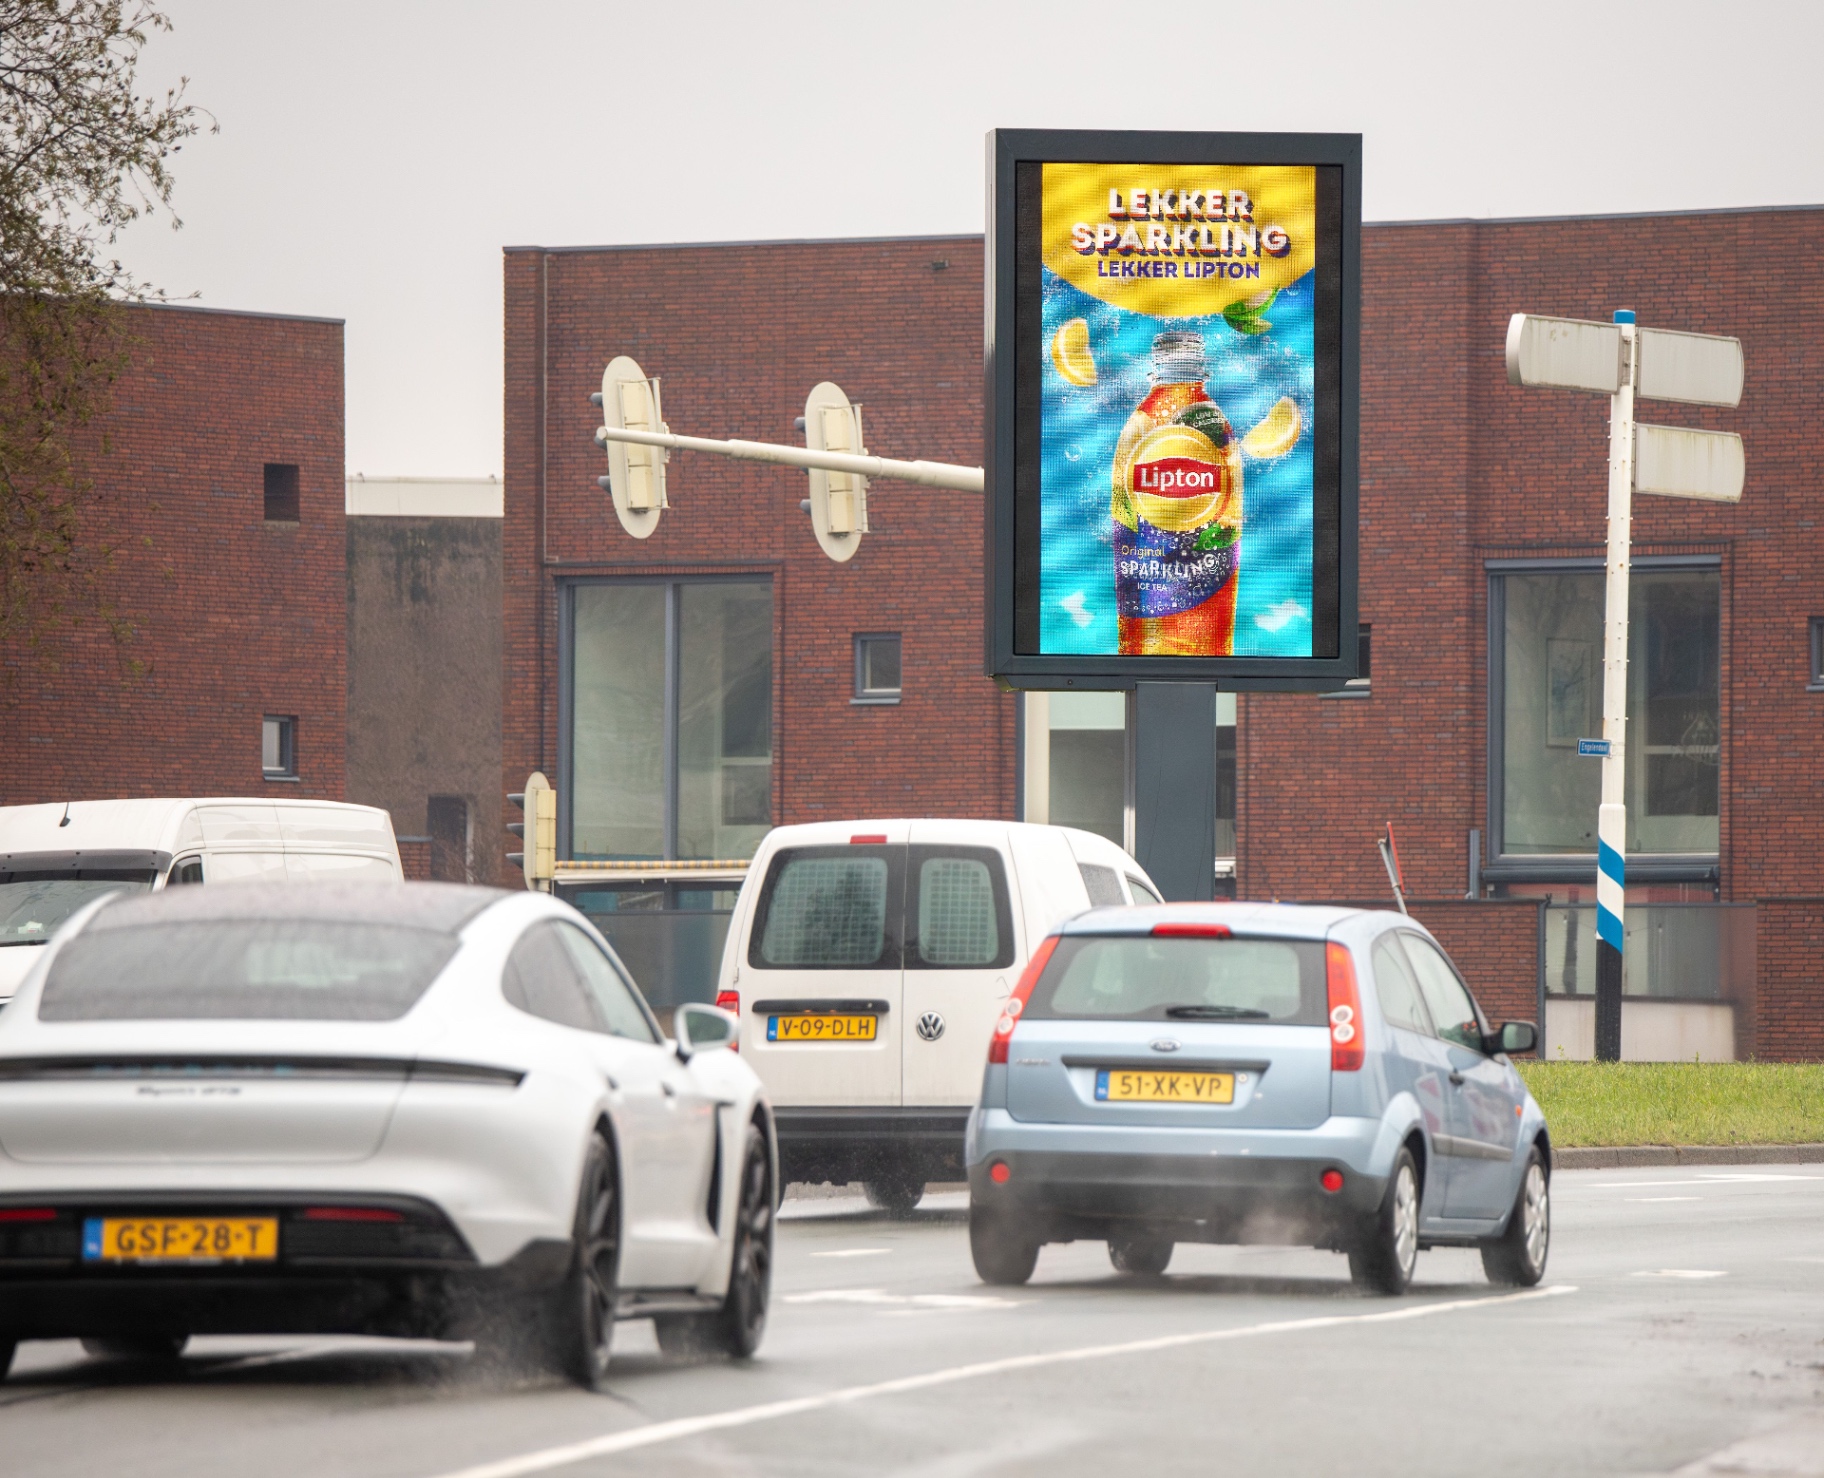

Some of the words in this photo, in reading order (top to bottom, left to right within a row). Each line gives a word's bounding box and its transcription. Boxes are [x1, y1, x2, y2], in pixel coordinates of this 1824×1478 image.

[1109, 188, 1253, 222] LEKKER
[1071, 222, 1291, 258] SPARKLING
[1098, 260, 1178, 278] LEKKER
[1184, 261, 1260, 279] LIPTON
[1140, 467, 1214, 492] Lipton
[1121, 545, 1165, 559] Original
[1120, 553, 1216, 578] SPARKLING
[1137, 582, 1150, 590] ICE
[783, 1019, 870, 1036] V-09-DLH
[1120, 1075, 1221, 1097] 51-XK-VP
[116, 1223, 263, 1253] GSF-28-T
